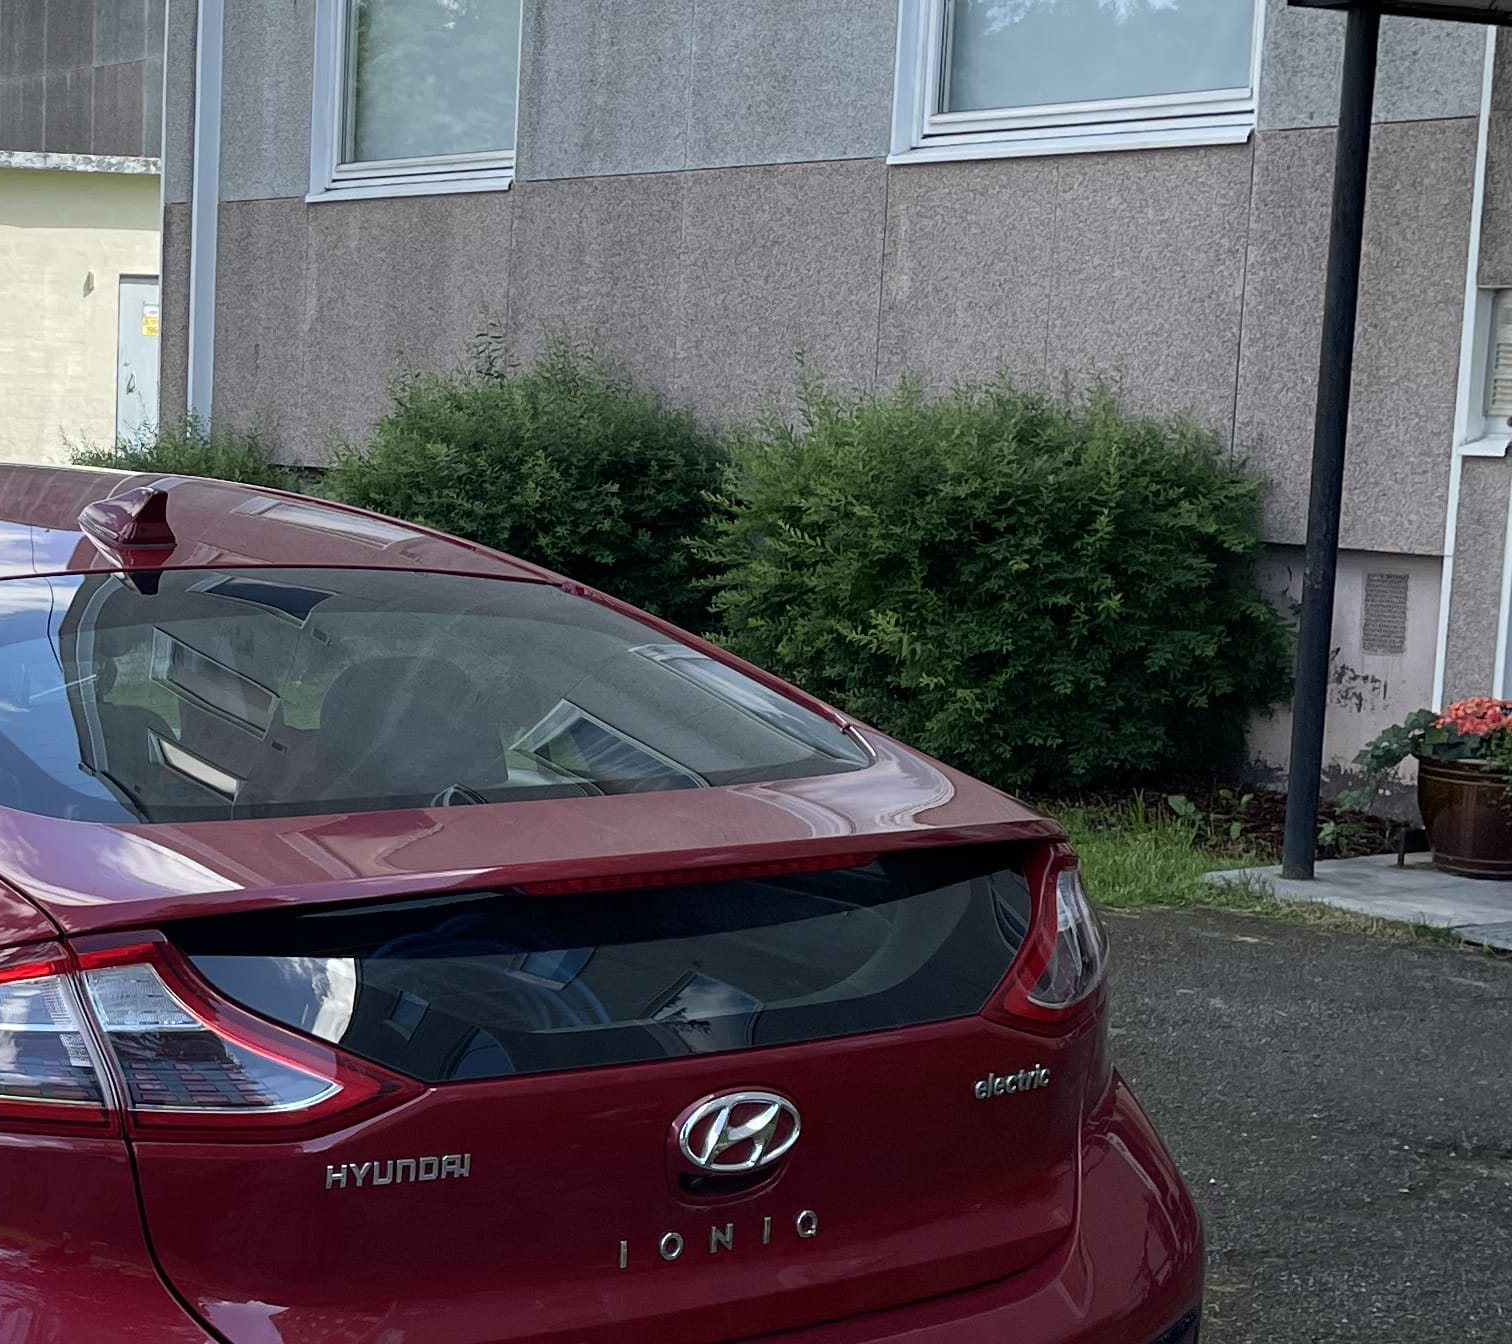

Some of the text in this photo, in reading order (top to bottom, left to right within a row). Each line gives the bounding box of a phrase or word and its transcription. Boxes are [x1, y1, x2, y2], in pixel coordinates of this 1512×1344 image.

[973, 1063, 1051, 1099] electric
[325, 1153, 471, 1189] HYUNDAI
[619, 1209, 819, 1269] IONIQ
